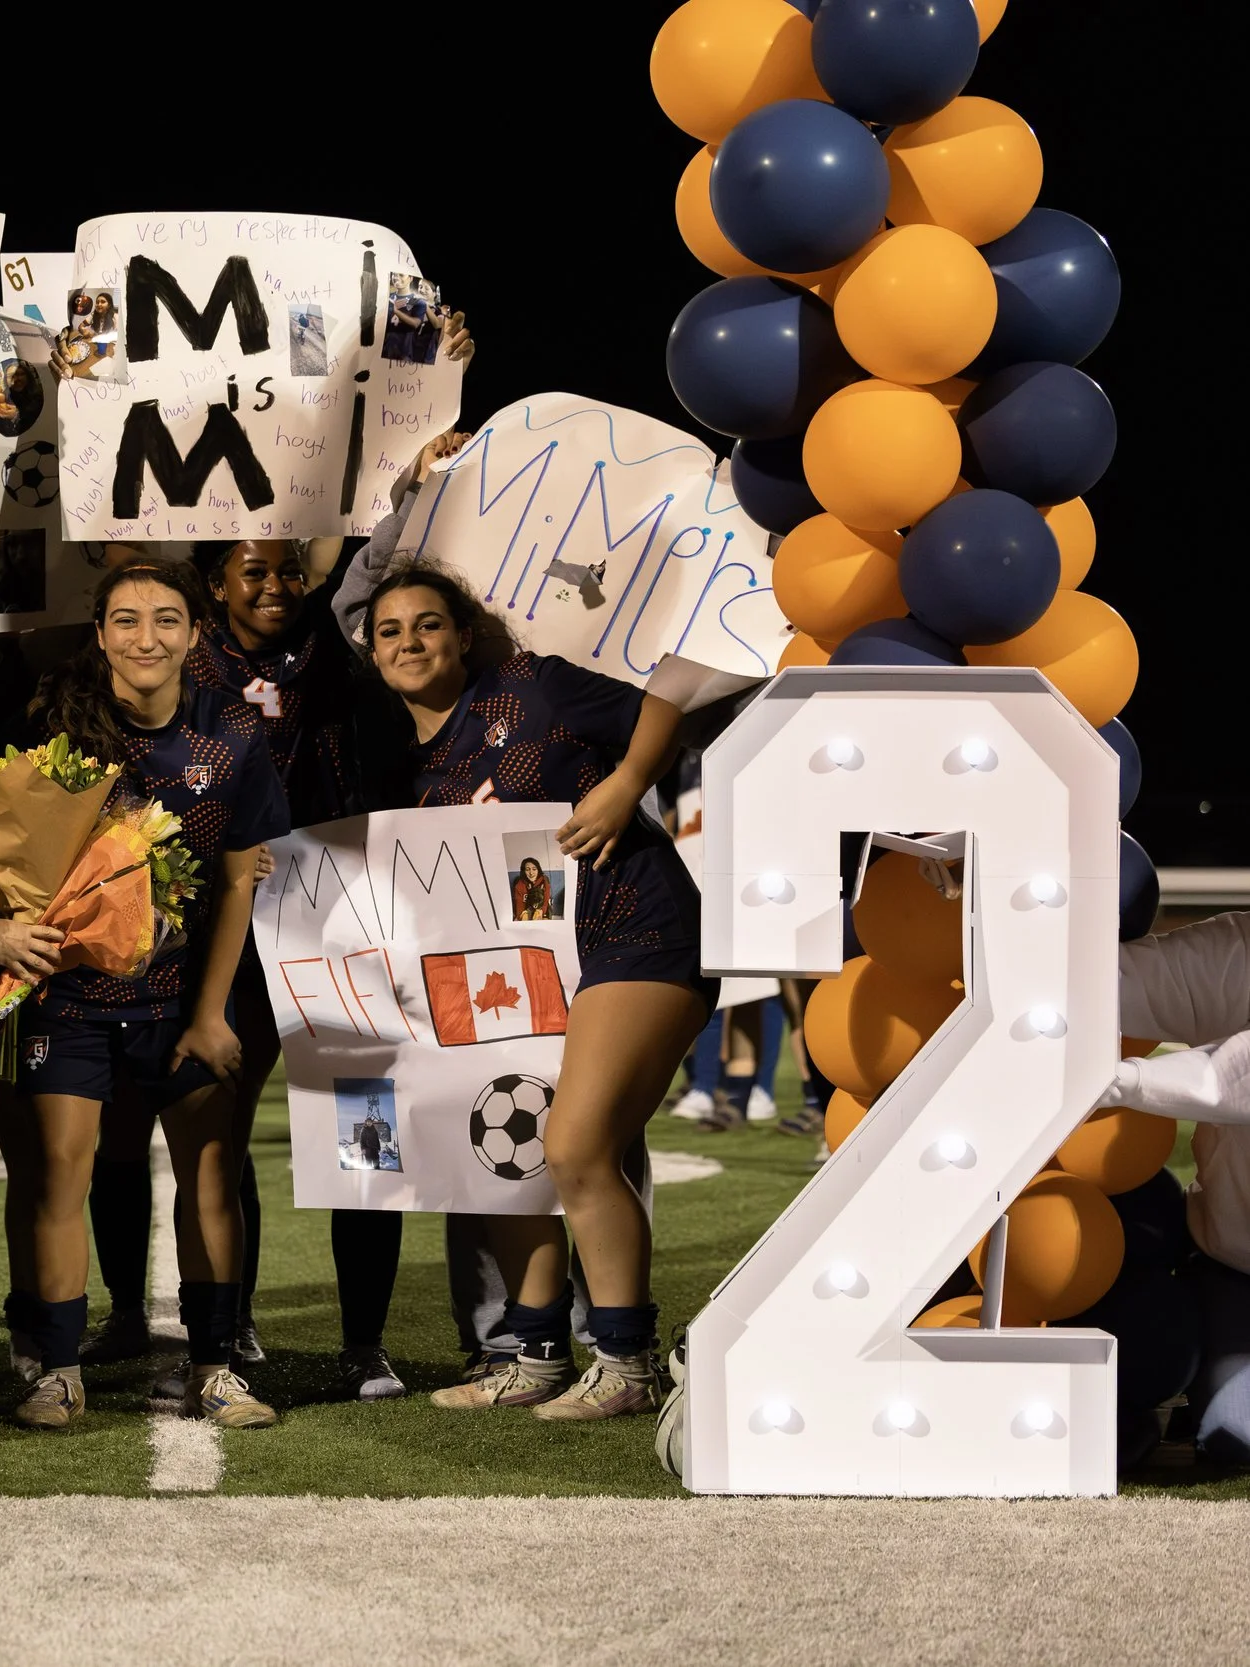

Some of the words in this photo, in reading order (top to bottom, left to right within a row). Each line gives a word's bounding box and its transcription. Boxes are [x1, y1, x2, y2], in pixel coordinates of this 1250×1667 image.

[136, 218, 208, 247] very
[4, 256, 35, 292] 67
[224, 373, 276, 413] is
[388, 378, 424, 399] hoyt
[275, 425, 327, 460] hoyt
[242, 676, 284, 719] 4
[199, 771, 208, 786] G
[275, 836, 500, 949] MIMI
[279, 947, 418, 1043] FIFI
[684, 666, 1121, 1498] 2
